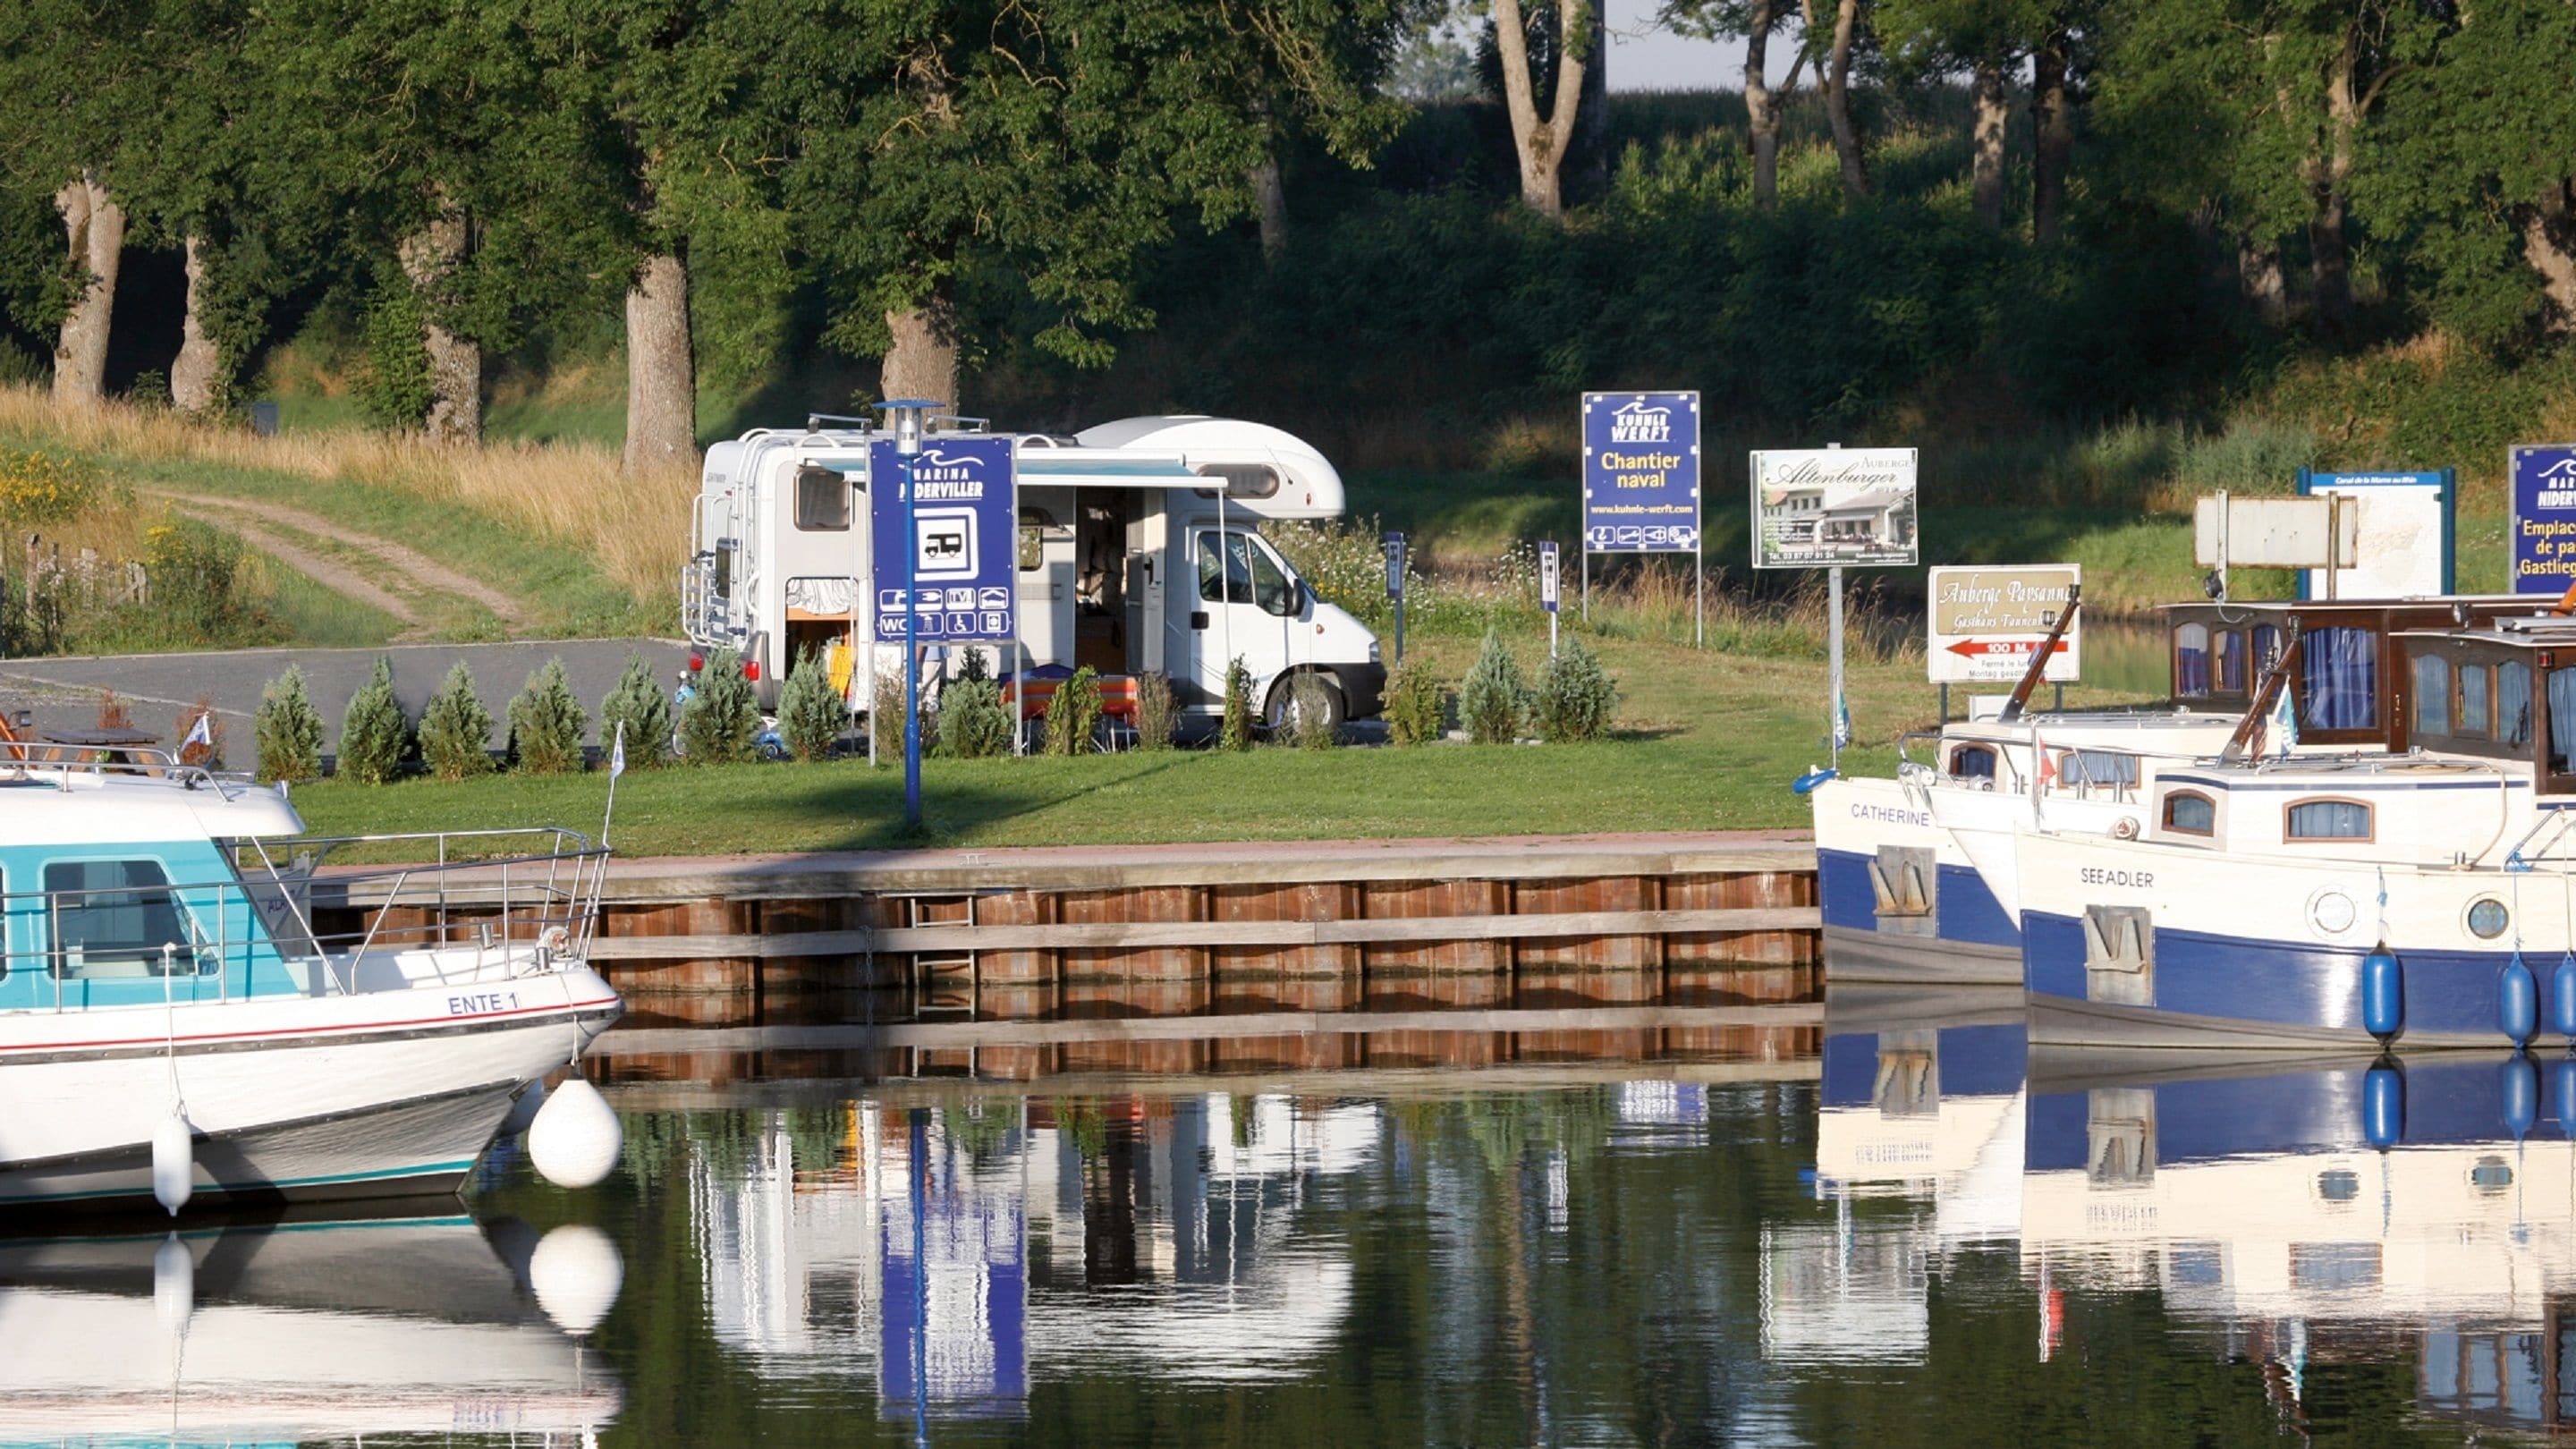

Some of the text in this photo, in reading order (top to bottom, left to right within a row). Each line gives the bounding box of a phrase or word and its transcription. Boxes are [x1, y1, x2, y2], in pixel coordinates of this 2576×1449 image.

[1612, 427, 1671, 441] WERFT
[1601, 452, 1681, 470] Chantier
[913, 468, 969, 480] MARINA
[1617, 471, 1665, 487] naval
[1766, 457, 1897, 491] Altenburger
[1591, 504, 1693, 514] www.kuhnle-werft.com
[2537, 539, 2554, 555] de
[1939, 574, 2002, 614] Auberge
[882, 618, 908, 631] WC
[1987, 643, 2029, 653] 100 M.
[1852, 803, 1929, 827] CATHERINE
[2080, 868, 2154, 889] SEEADLER
[448, 992, 518, 1014] ENTE 1
